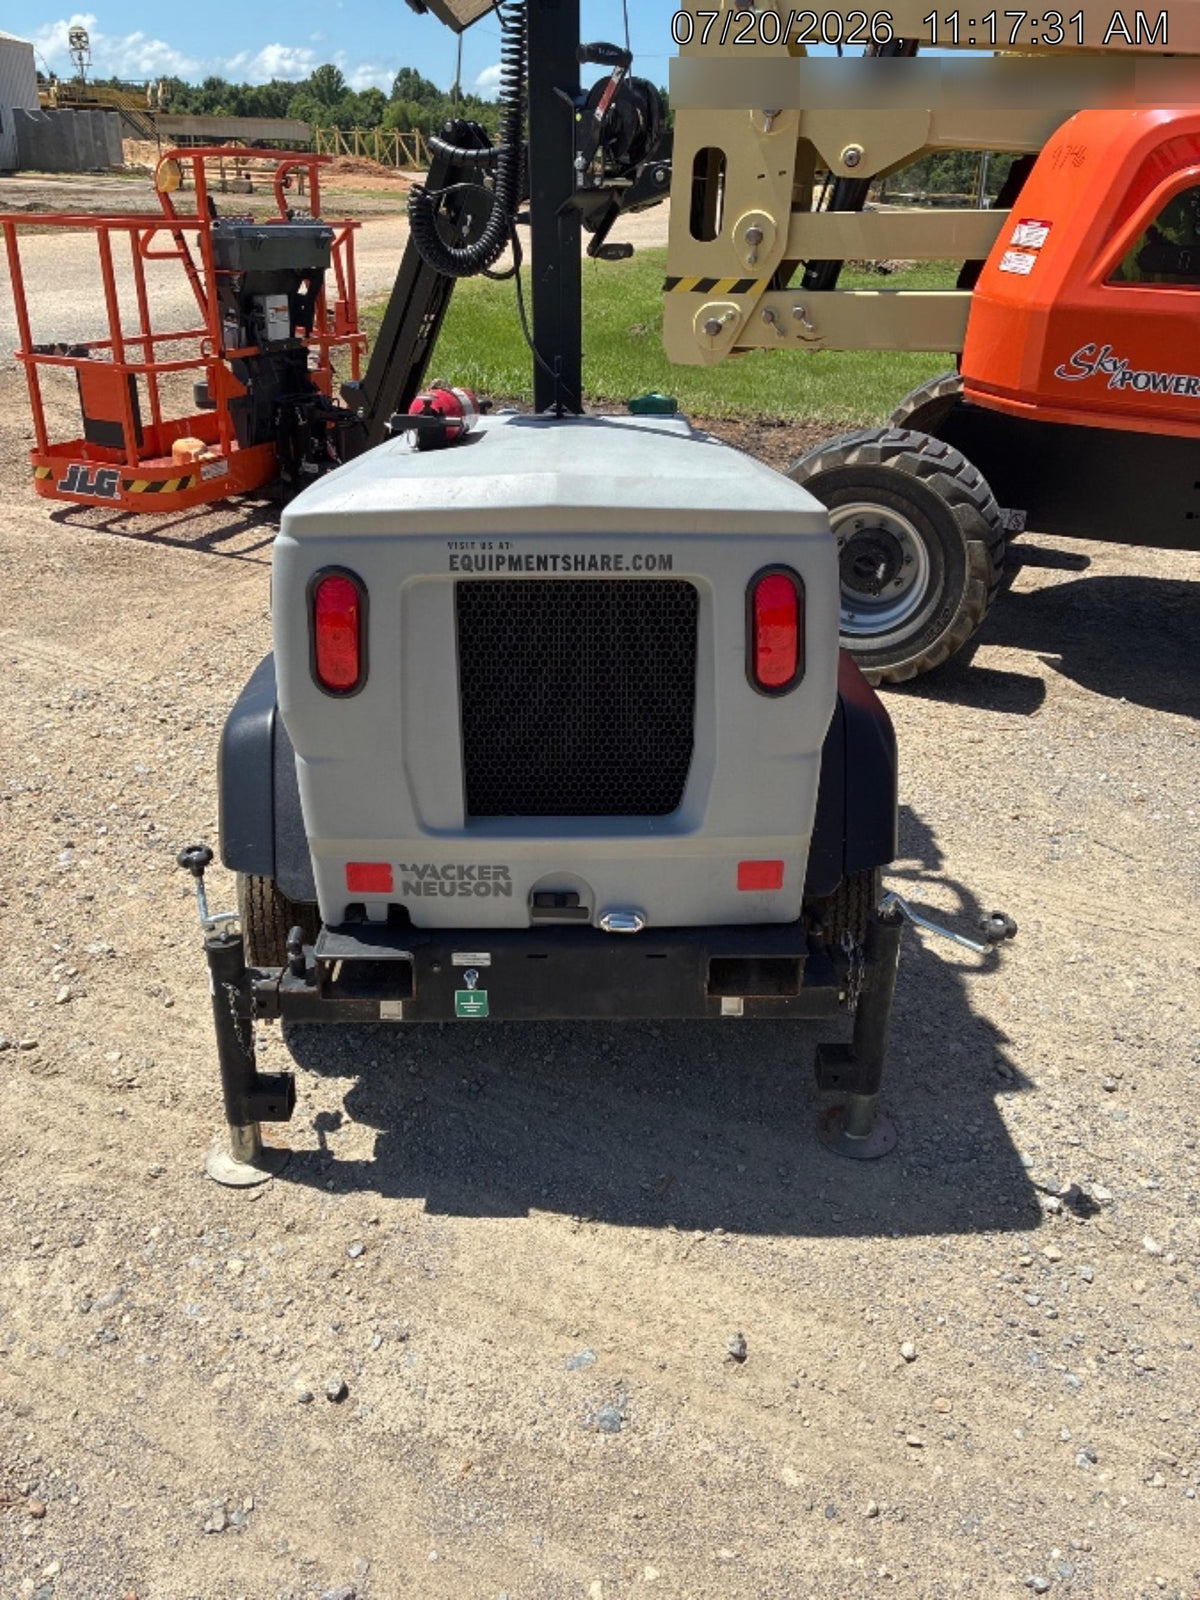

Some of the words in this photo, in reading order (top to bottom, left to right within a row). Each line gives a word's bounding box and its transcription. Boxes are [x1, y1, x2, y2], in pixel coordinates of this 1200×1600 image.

[56, 463, 121, 500] JLG
[447, 541, 475, 550] VISIT
[480, 541, 493, 550] US
[448, 554, 673, 573] EQUIPMENTSHARE.COM
[399, 863, 512, 881] WACKER
[402, 881, 513, 897] NEUSON
